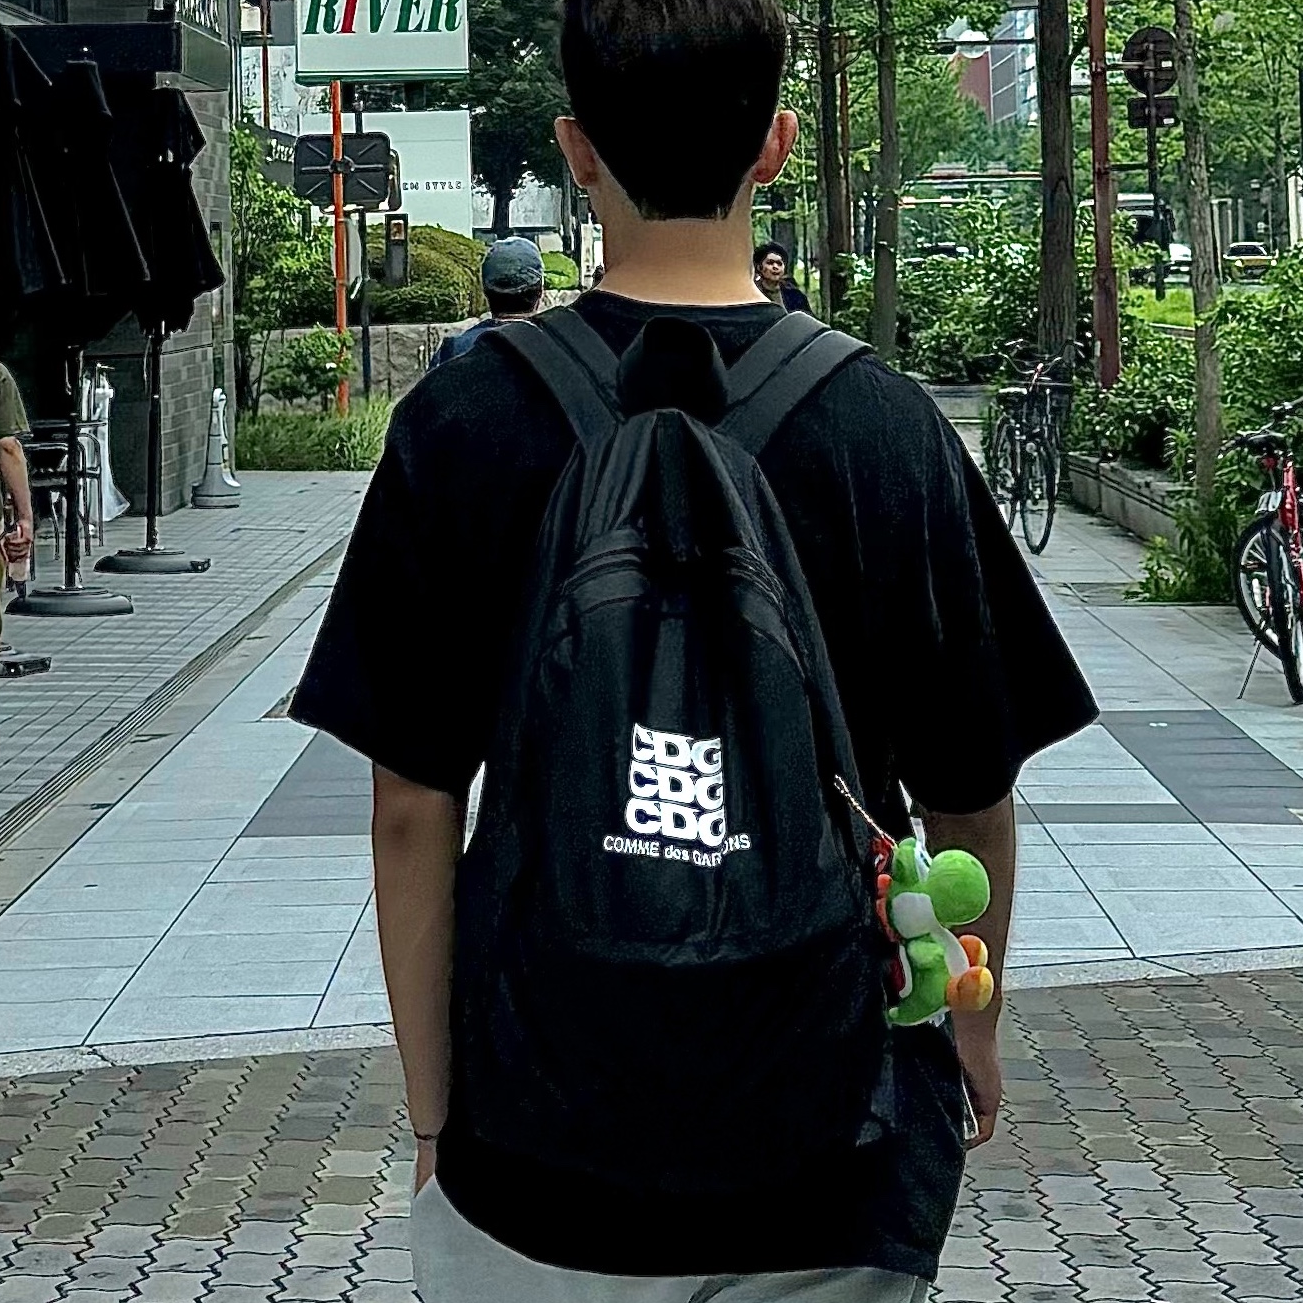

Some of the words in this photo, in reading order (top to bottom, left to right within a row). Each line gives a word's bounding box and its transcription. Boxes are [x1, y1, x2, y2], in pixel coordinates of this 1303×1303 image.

[632, 722, 722, 776] CDG
[629, 758, 724, 811] CDG
[603, 835, 660, 857] COMME
[625, 796, 726, 847] CDG
